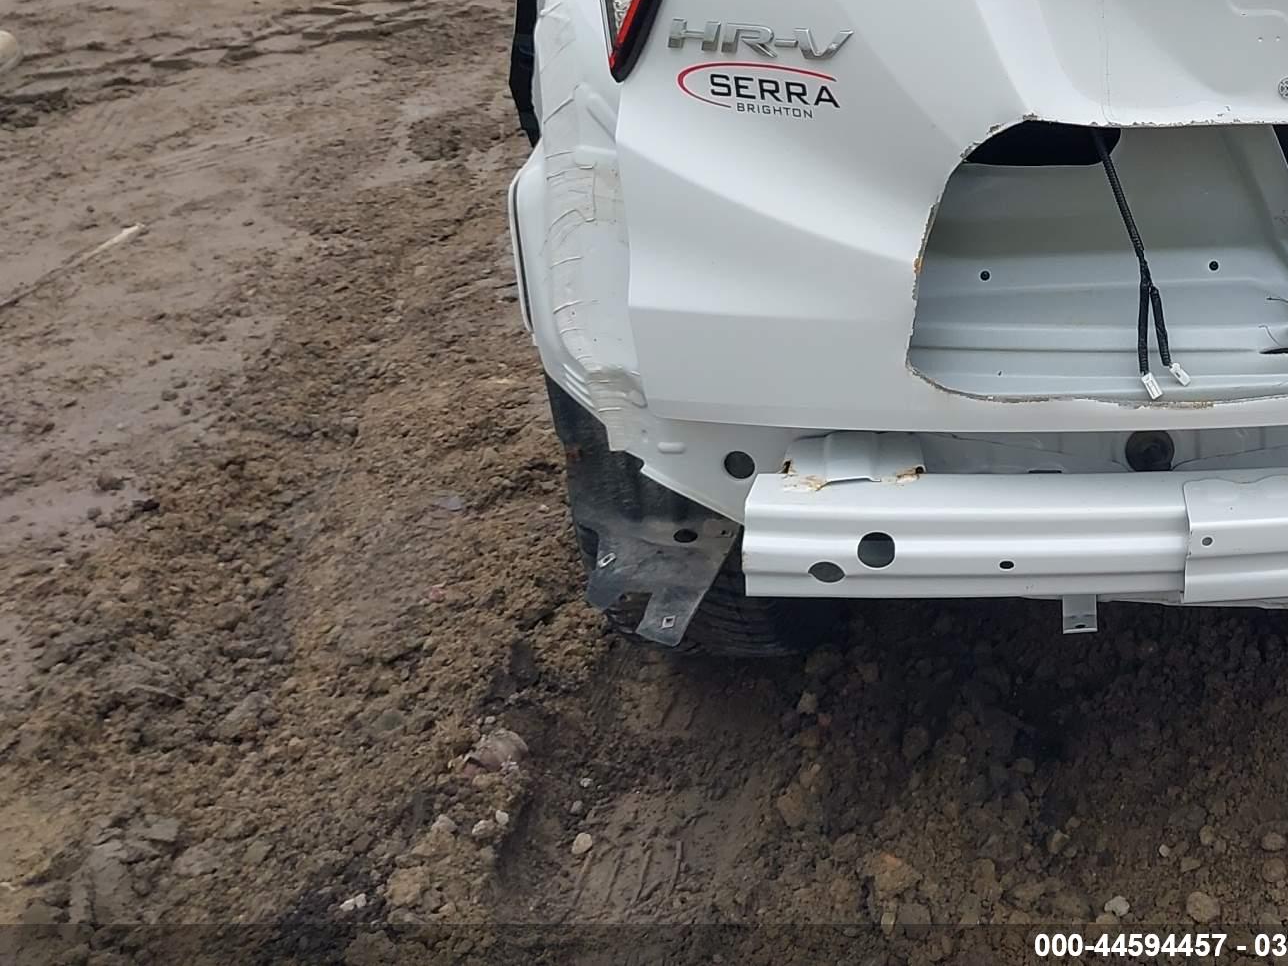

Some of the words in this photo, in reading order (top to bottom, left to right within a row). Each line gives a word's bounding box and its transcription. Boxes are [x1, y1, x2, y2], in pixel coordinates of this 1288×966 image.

[667, 18, 854, 60] HR-V
[710, 73, 840, 108] SERRA
[736, 102, 813, 119] BRIGHTON
